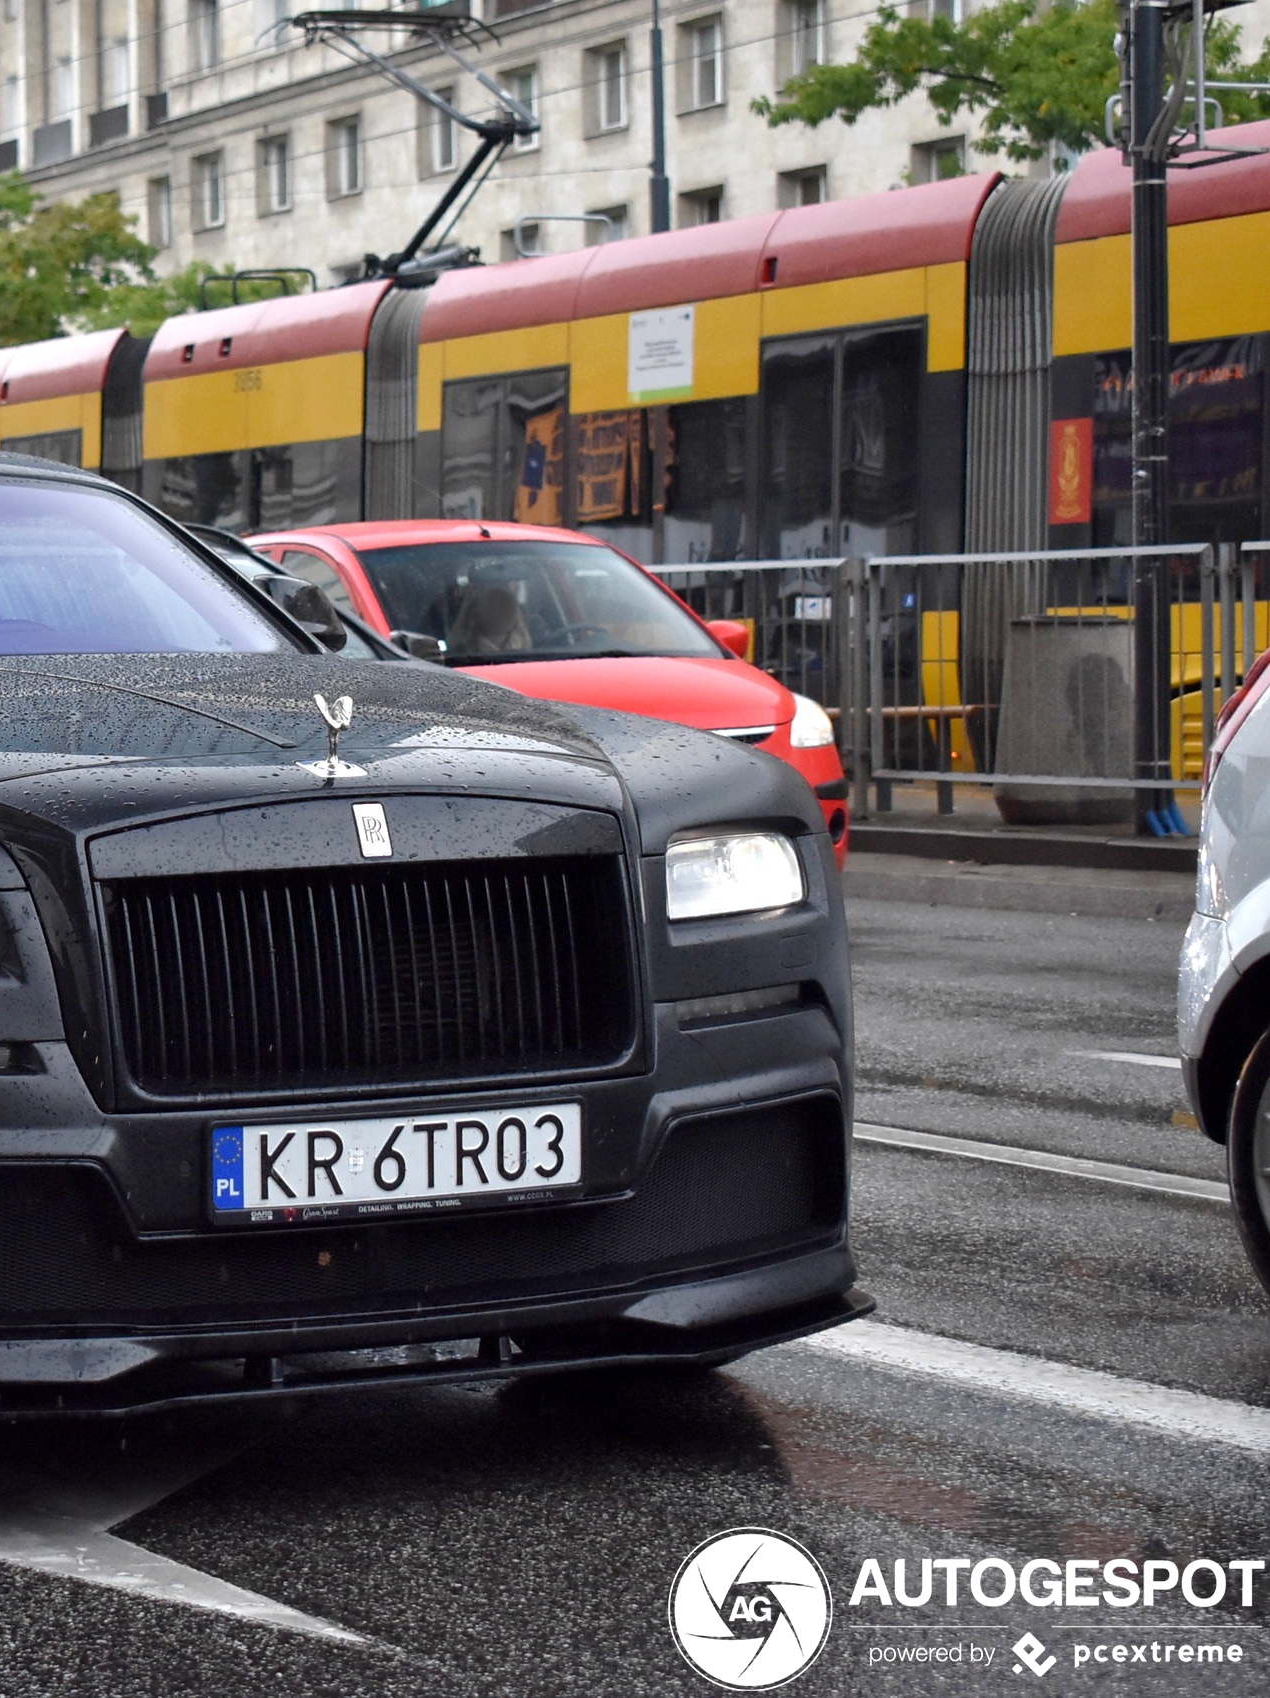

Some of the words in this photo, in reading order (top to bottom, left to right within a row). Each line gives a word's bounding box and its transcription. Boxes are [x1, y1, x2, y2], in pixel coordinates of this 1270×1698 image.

[361, 816, 386, 844] RR
[260, 1128, 344, 1200] KR
[373, 1113, 564, 1192] 6TR03
[216, 1178, 240, 1197] PL
[358, 1203, 394, 1213] DETAILING.
[396, 1200, 433, 1210] WRAPPING.
[435, 1199, 462, 1207] TUNING.
